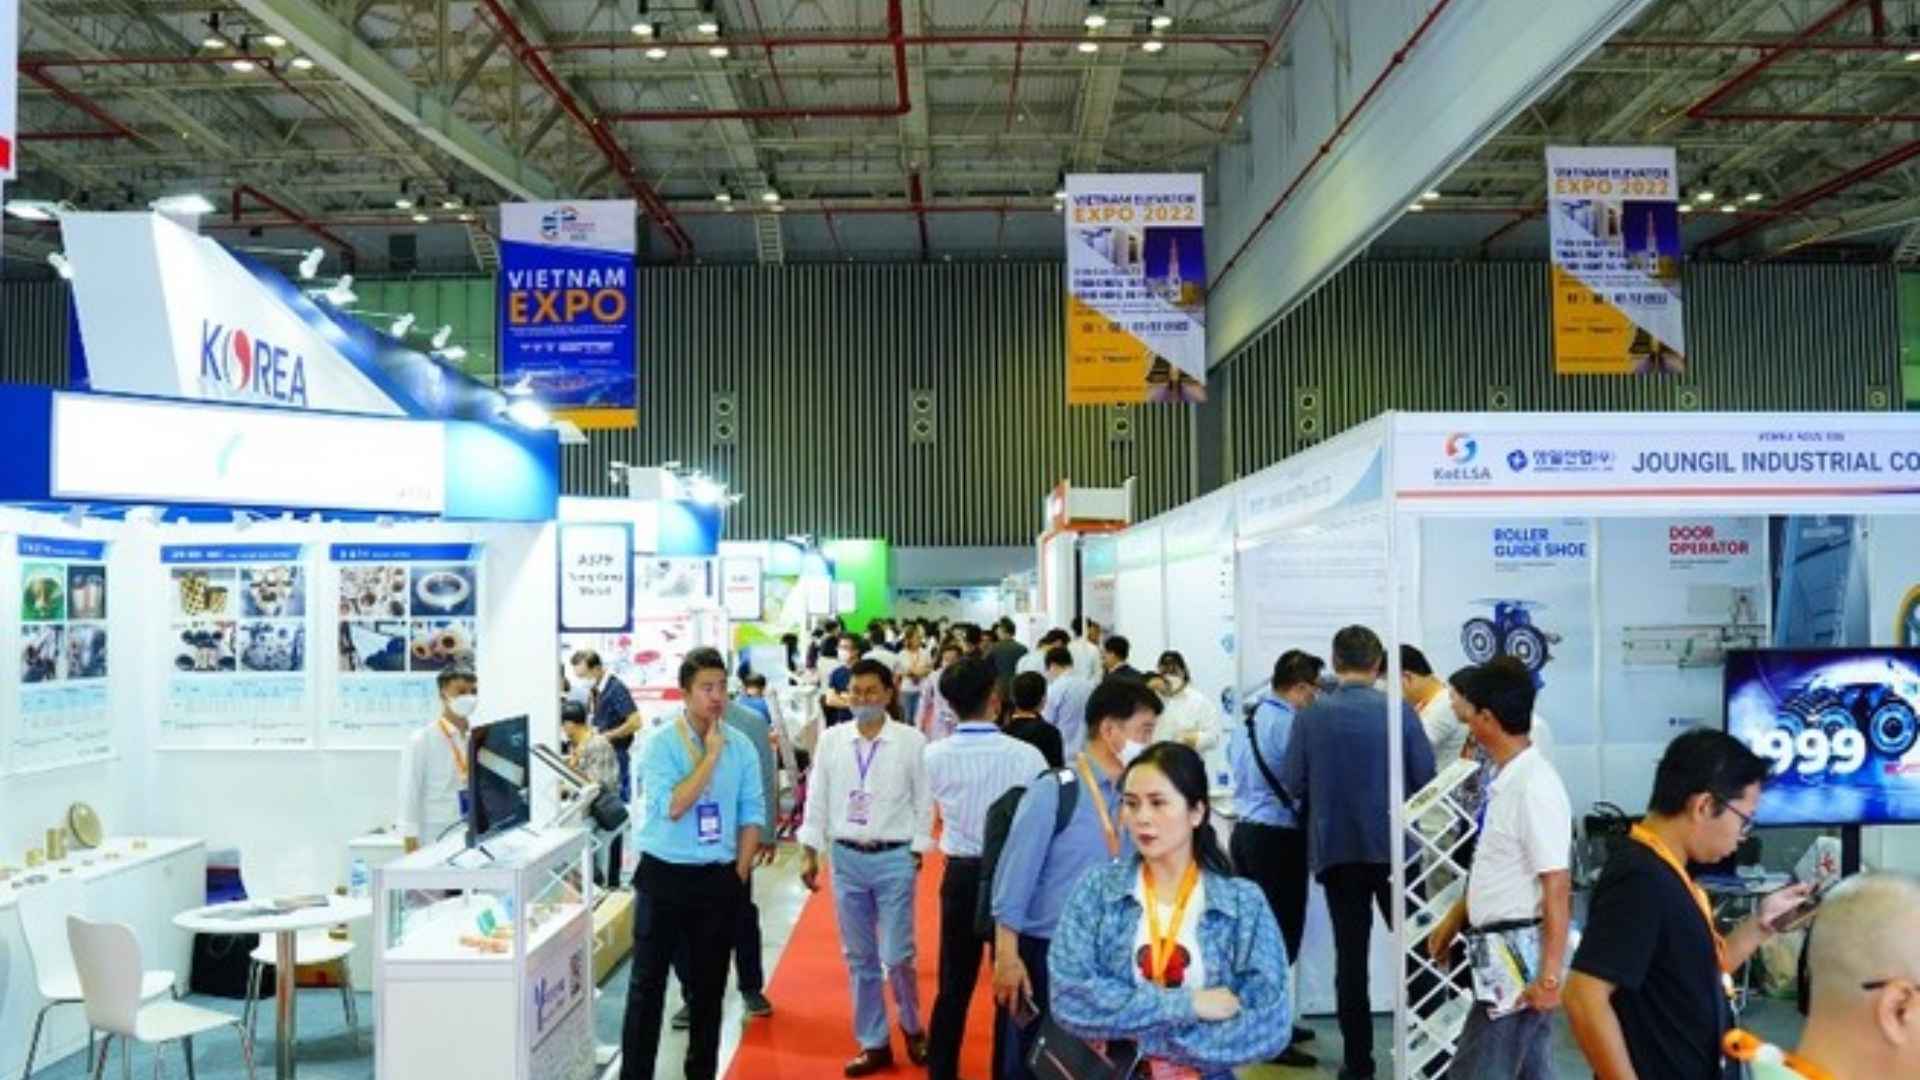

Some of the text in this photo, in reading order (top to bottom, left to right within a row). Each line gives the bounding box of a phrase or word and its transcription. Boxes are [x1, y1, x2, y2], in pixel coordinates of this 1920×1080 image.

[1556, 177, 1612, 194] EXPO
[1074, 206, 1195, 223] EXPO 2022
[508, 268, 626, 289] VIETNAM
[509, 289, 626, 324] EXPO
[200, 318, 308, 409] KOREA
[1631, 452, 1736, 473] JOUNGIL
[1742, 451, 1882, 472] INDUSTRIAL
[1494, 528, 1549, 542] ROLLER
[1669, 526, 1715, 540] DOOR
[1494, 542, 1587, 558] GUIDE SHOE
[1669, 540, 1750, 556] OPERATOR
